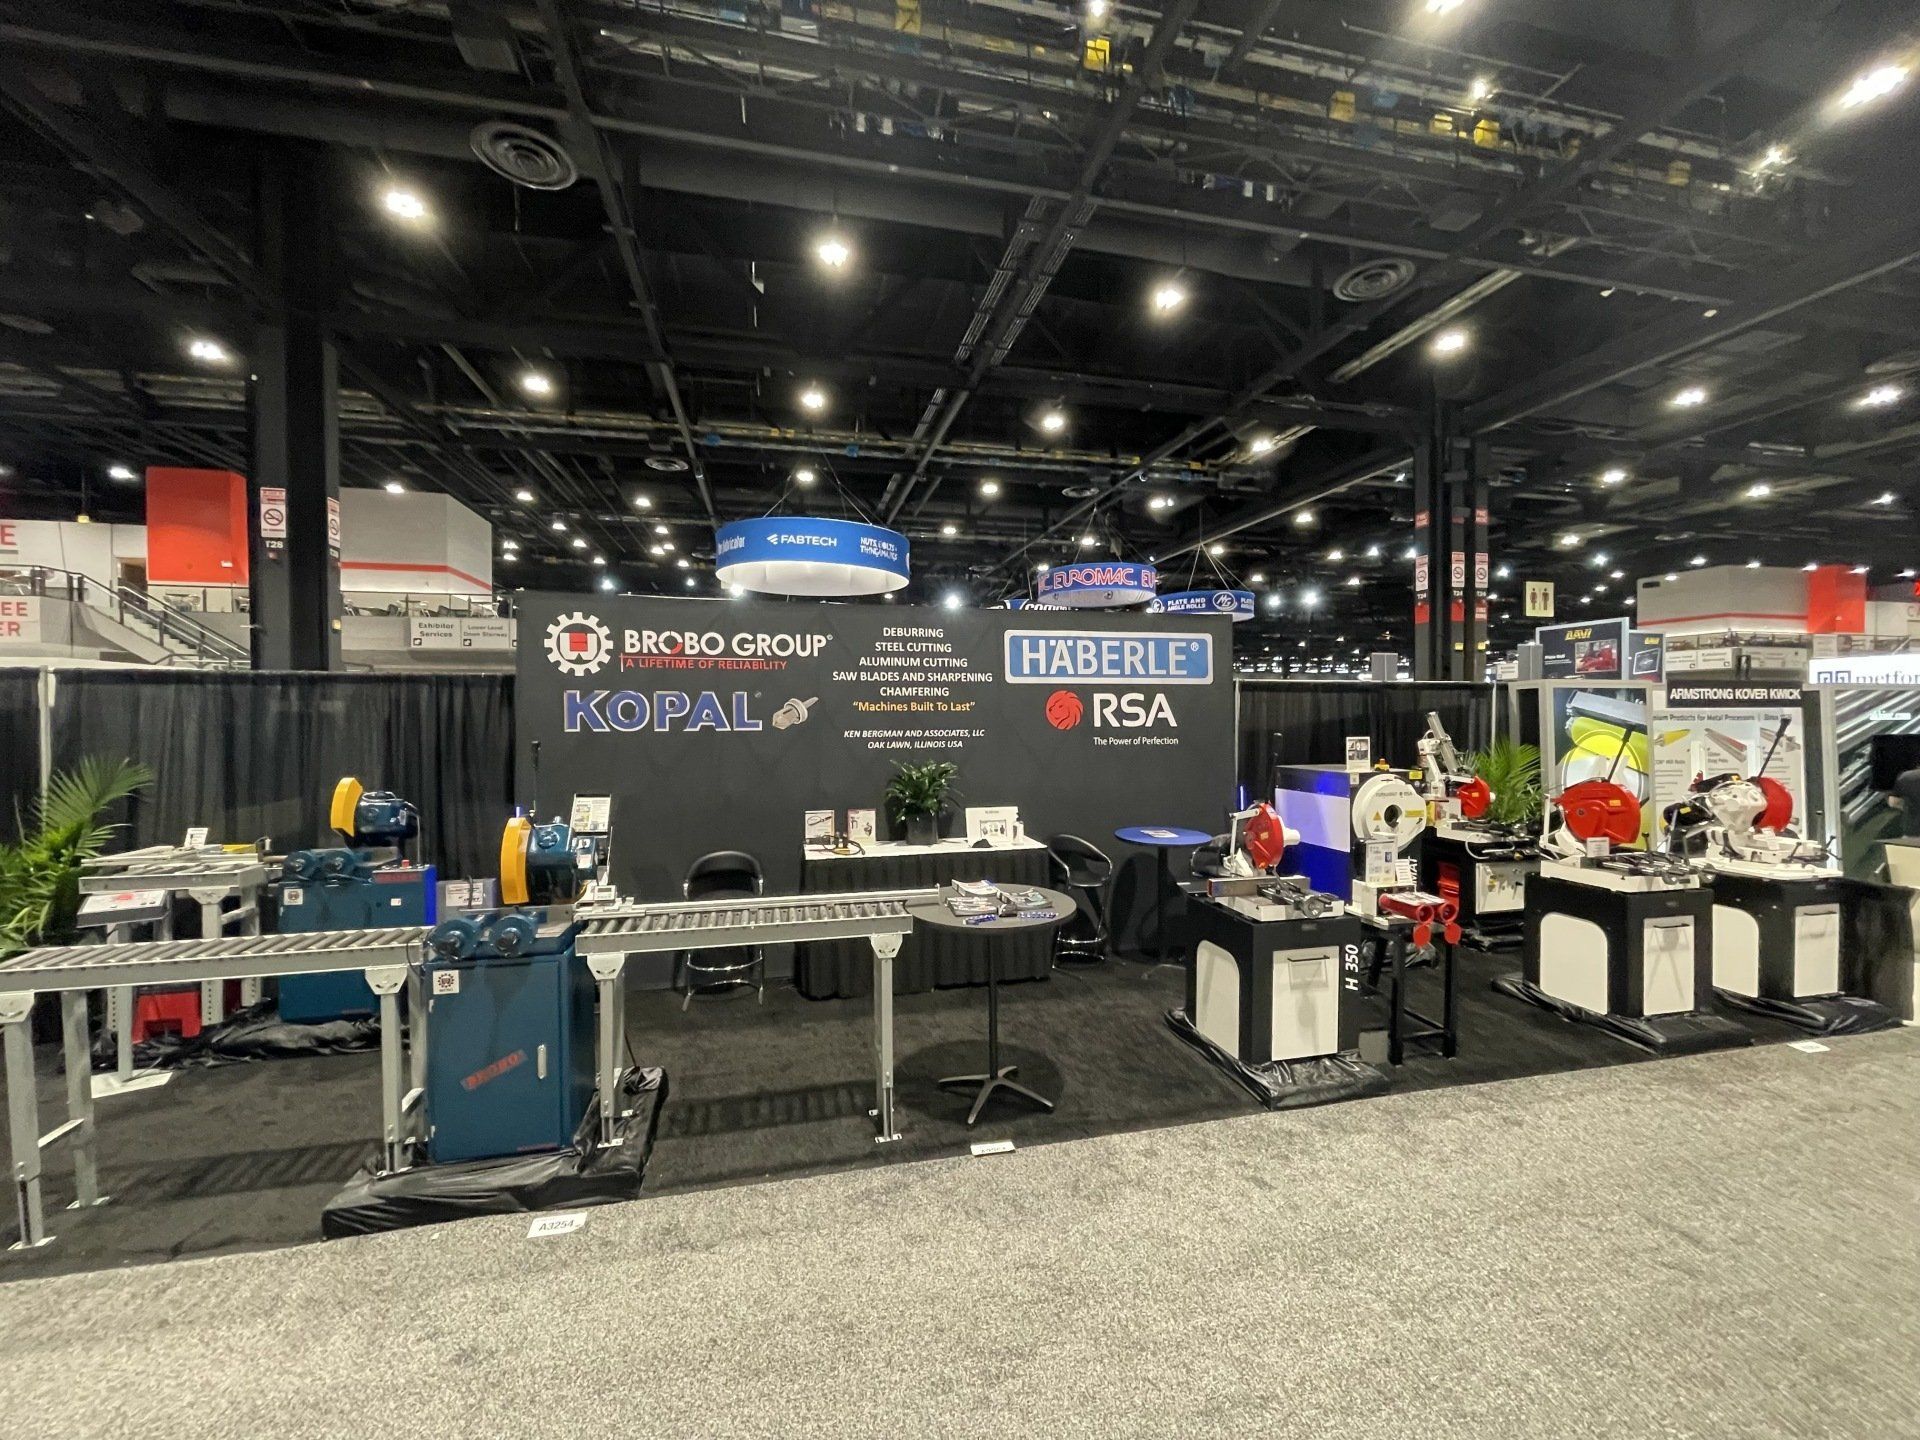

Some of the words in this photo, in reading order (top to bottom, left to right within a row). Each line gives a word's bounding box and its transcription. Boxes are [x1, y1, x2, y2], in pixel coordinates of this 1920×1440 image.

[781, 534, 838, 547] FABTECH
[1053, 567, 1134, 590] EUROMAC
[418, 622, 454, 630] Exhibitor
[883, 627, 944, 638] DEBURRING
[624, 629, 725, 656] BROBO
[875, 641, 905, 652] STEEL
[906, 642, 952, 653] CUTTING
[626, 658, 634, 669] A
[639, 658, 695, 670] LIFETIME
[699, 659, 714, 670] OF
[718, 660, 788, 671] RELIABILITY
[859, 657, 920, 667] ALUMINUM
[923, 657, 968, 668] CUTTING
[832, 671, 857, 681] SAW
[860, 671, 900, 681] BLADES
[902, 672, 925, 682] AND
[927, 672, 993, 682] SHARPENING
[880, 687, 950, 697] CHAMFERING
[1669, 688, 1734, 700] ARMSTRONG
[1735, 688, 1768, 700] KOVER
[1769, 688, 1801, 700] KWICK
[563, 689, 763, 732] KOPAL
[910, 701, 934, 712] Built
[936, 702, 948, 711] To
[1093, 692, 1178, 728] RSA
[844, 730, 861, 738] KEN
[862, 729, 903, 738] BERGMAN
[904, 729, 923, 738] AND
[924, 729, 971, 738] ASSOCIATES,
[972, 729, 985, 737] LLC
[867, 741, 886, 749] OAK
[886, 741, 913, 750] LAWN,
[914, 740, 946, 749] ILLINOIS
[947, 740, 963, 748] USA
[1093, 736, 1108, 745] The
[1109, 736, 1132, 745] Power
[1133, 736, 1141, 745] of
[1142, 736, 1179, 745] Perfection
[1345, 944, 1359, 973] 350
[1345, 977, 1359, 991] H
